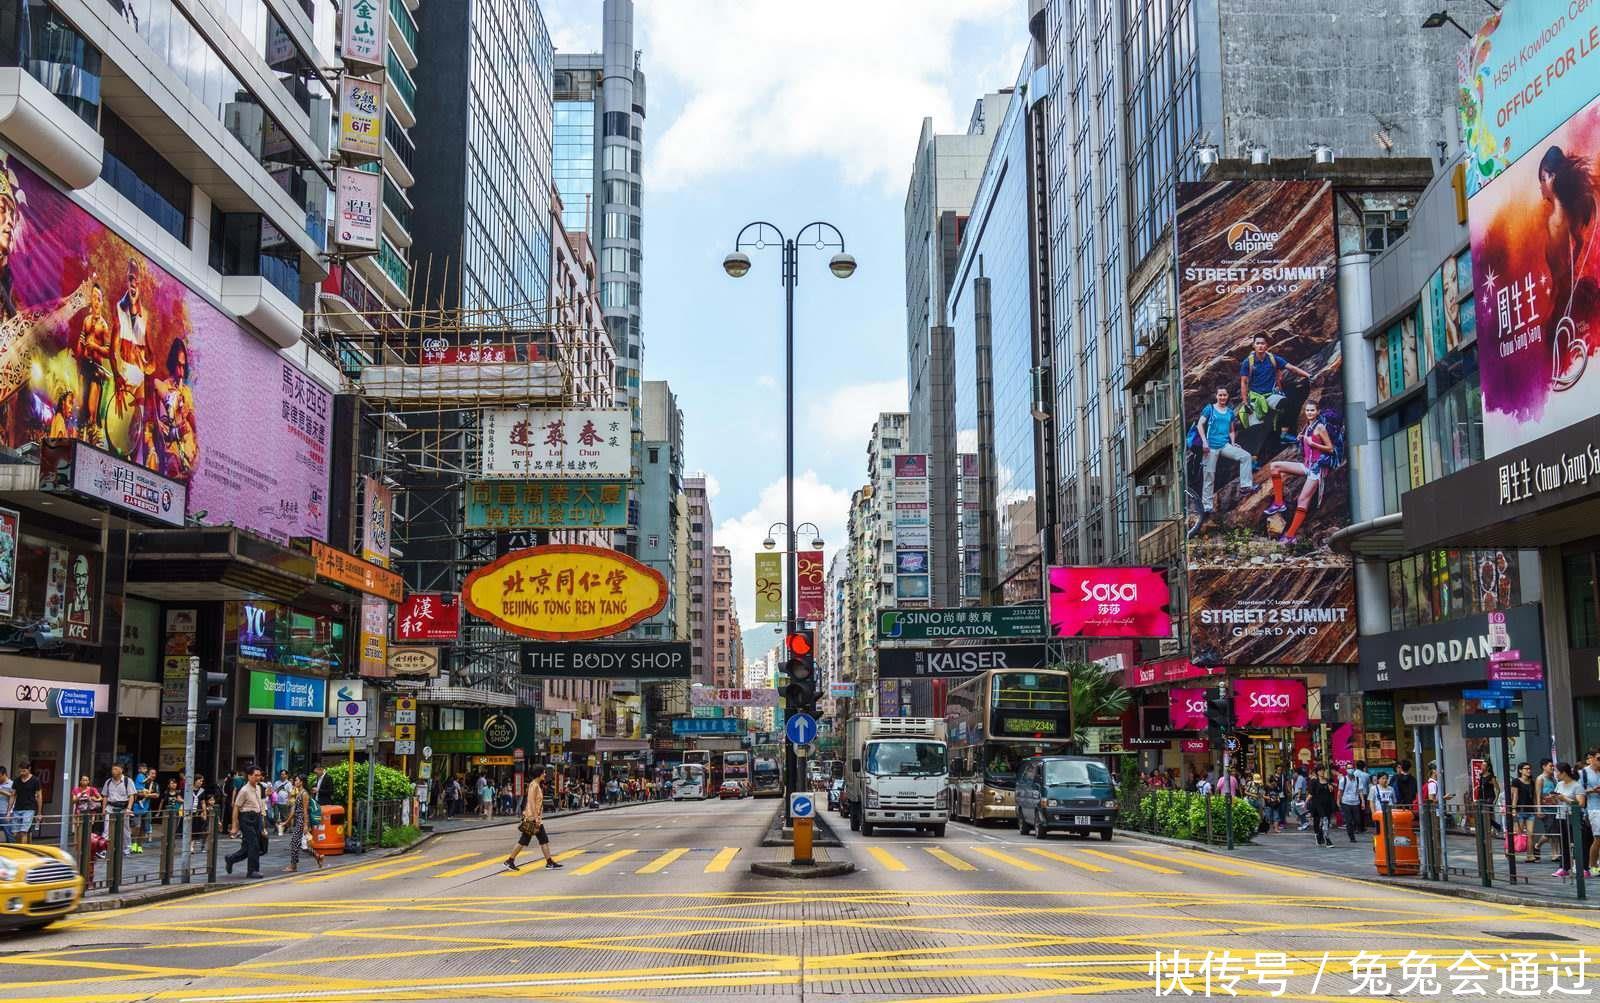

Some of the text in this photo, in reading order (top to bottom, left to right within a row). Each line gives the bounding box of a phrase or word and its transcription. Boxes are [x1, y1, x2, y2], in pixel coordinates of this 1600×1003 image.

[1493, 56, 1517, 90] HSH
[1519, 15, 1566, 63] Kowloon
[1497, 75, 1543, 128] OFFICE
[1545, 47, 1576, 87] FOR
[352, 121, 371, 133] 6/F
[1245, 230, 1279, 241] Lowe
[1234, 241, 1274, 253] alpine
[1185, 266, 1327, 281] STREET 2 SUMMIT
[1497, 272, 1540, 338] 周生生
[1500, 325, 1542, 358] Chow Sang Sang
[282, 364, 327, 421] 馬來西亞
[509, 419, 604, 448] 蓬萊春
[511, 449, 533, 458] Peng
[578, 449, 600, 457] Chun
[1535, 462, 1561, 492] Chow
[1562, 452, 1587, 485] Sang
[1499, 458, 1532, 505] 周生生
[798, 559, 824, 585] 25
[503, 568, 628, 597] 北京同仁堂
[756, 577, 782, 602] 25
[1081, 579, 1138, 601] Sasa
[503, 599, 628, 618] BEIJING TONG REN TANG
[907, 611, 993, 624] SINO 尚華教育
[1097, 603, 1121, 615] 莎莎
[1201, 608, 1348, 624] STREET 2 SUMMIT
[68, 626, 89, 639] KFC
[1232, 626, 1318, 637] GIORDANO
[528, 652, 683, 669] THE BODY SHOP
[927, 651, 1008, 673] KAISER
[16, 684, 50, 702] G200
[1249, 691, 1290, 708] Sasa
[1186, 699, 1209, 713] Sas
